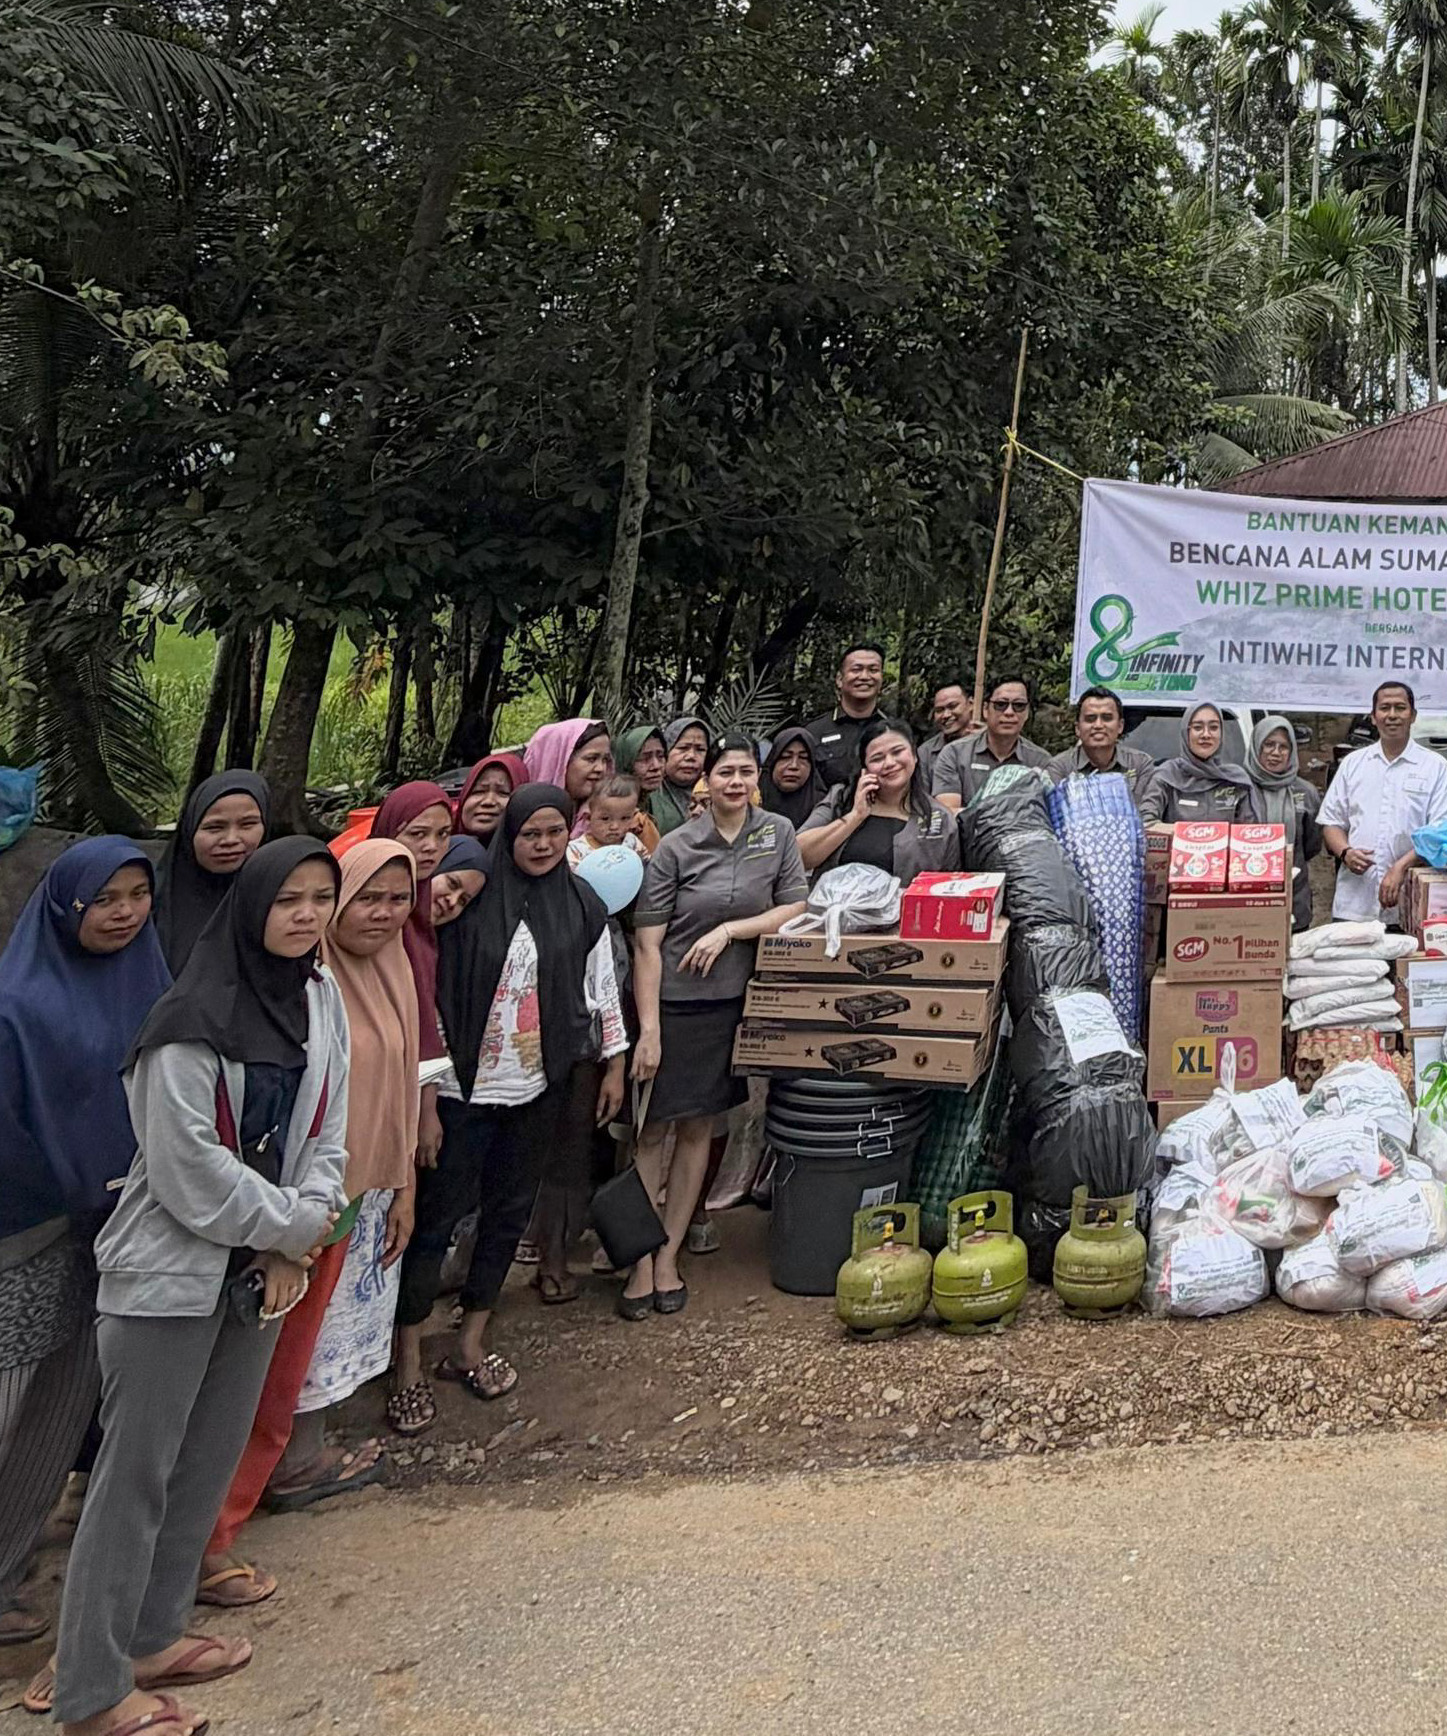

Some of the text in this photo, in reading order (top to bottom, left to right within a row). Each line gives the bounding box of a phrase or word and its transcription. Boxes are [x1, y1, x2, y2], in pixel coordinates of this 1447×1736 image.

[1247, 511, 1360, 533] BANTUAN
[1169, 541, 1291, 568] BENCANA
[1298, 547, 1372, 570] ALAM
[1196, 580, 1268, 606] WHIZ
[1276, 583, 1364, 610] PRIME
[1129, 654, 1205, 674] INFINITY
[1219, 640, 1338, 667] INTIWHIZ
[1187, 826, 1215, 838] SGM
[1244, 826, 1272, 839] SGM
[774, 938, 812, 949] Miyako
[1177, 941, 1205, 957] SGM
[1213, 936, 1232, 945] No.
[1233, 935, 1243, 959] 1
[1202, 1024, 1229, 1034] Pants
[1177, 1045, 1213, 1074] XL
